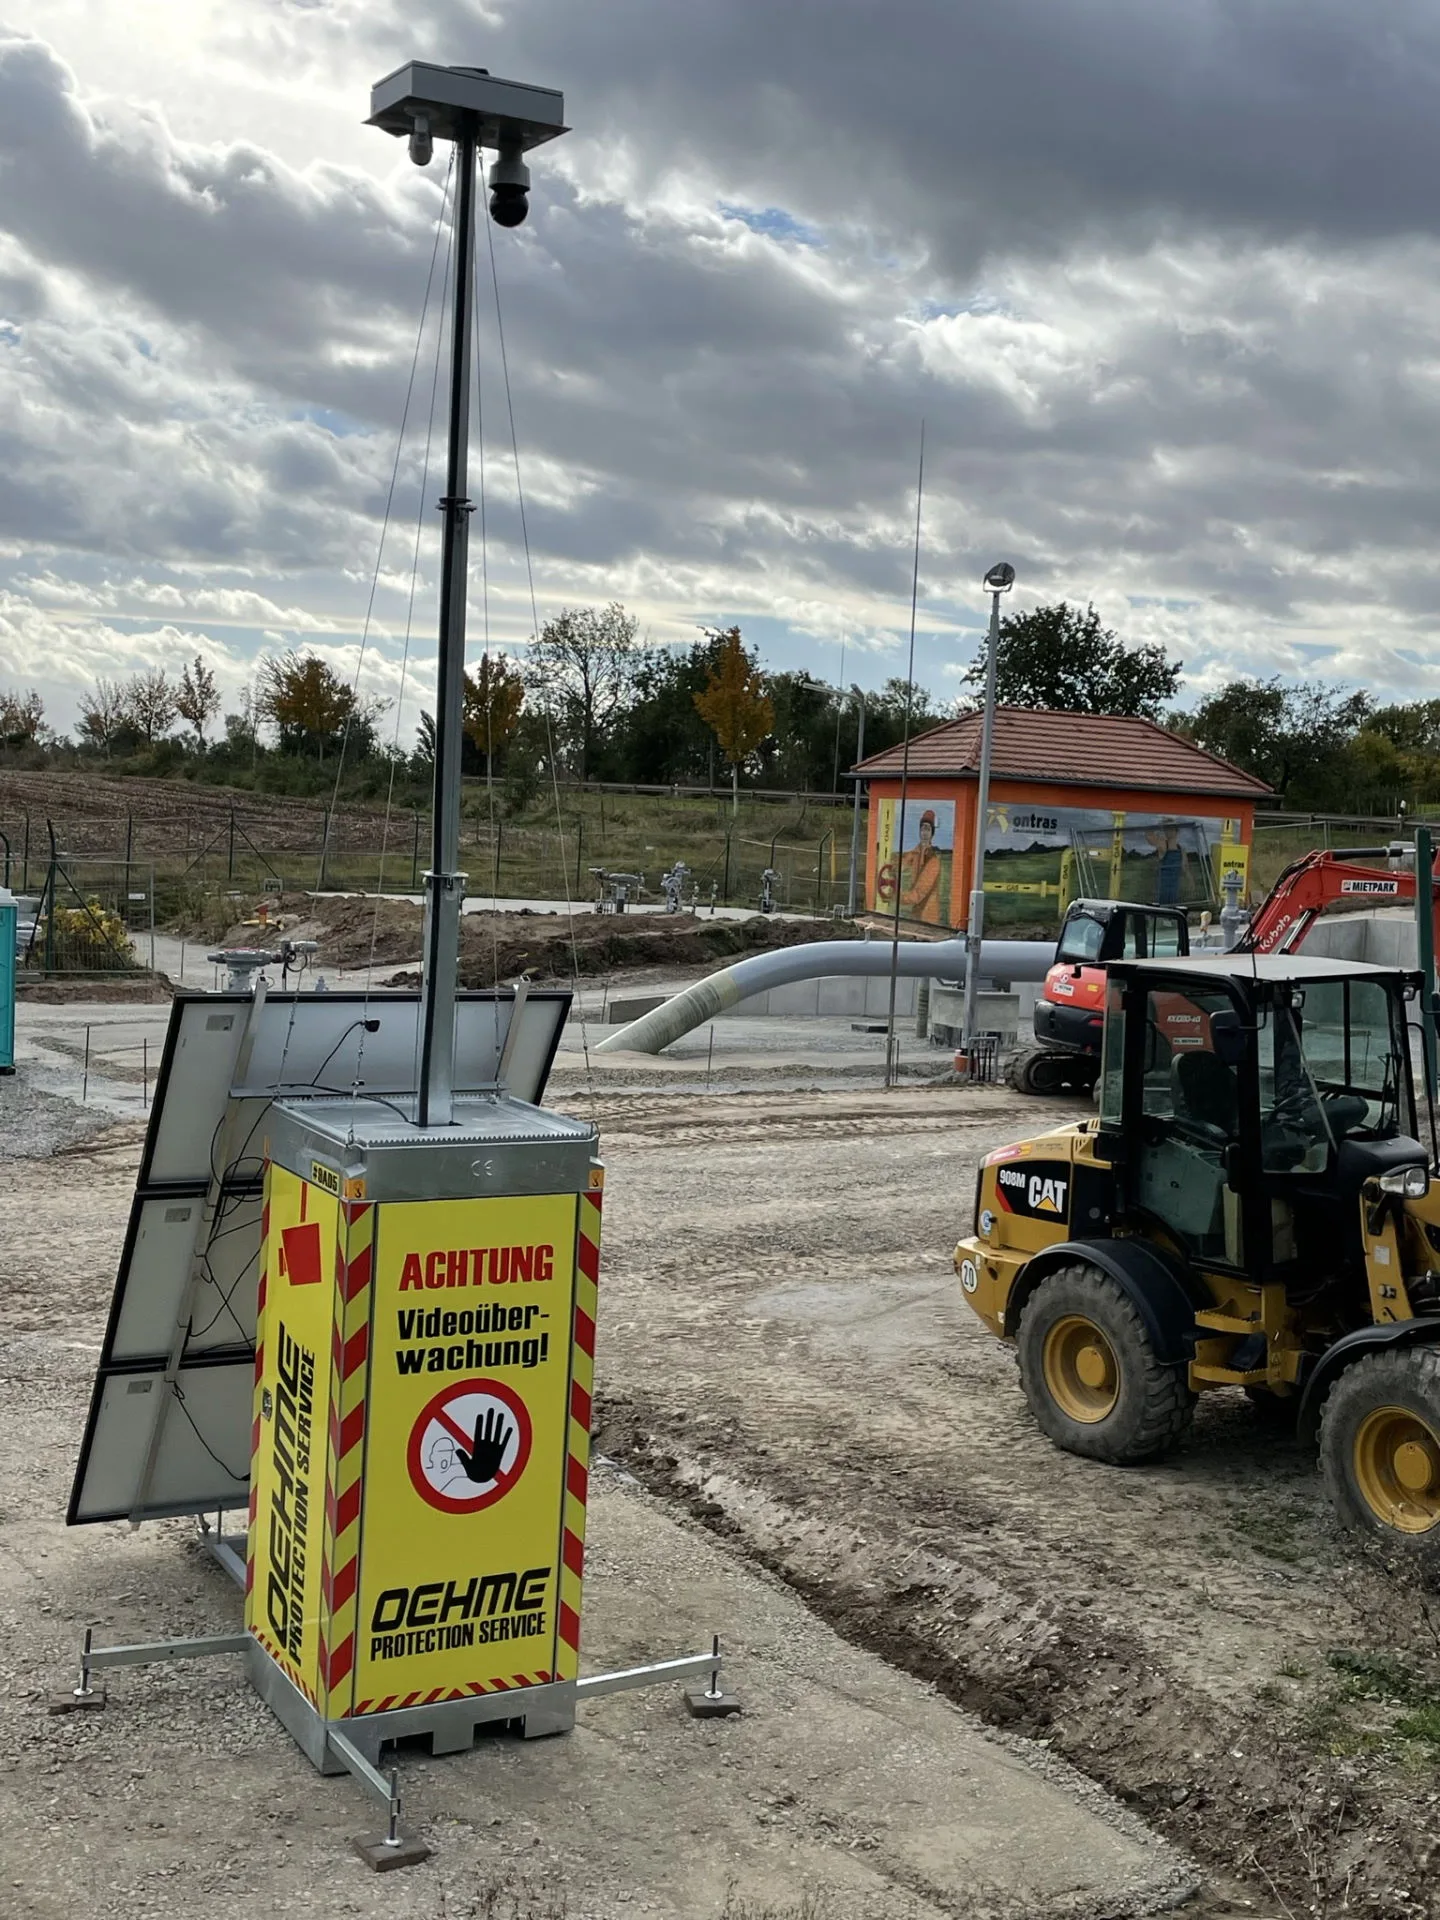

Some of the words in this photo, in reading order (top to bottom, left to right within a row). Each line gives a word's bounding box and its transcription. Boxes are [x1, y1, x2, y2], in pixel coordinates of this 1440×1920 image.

[1013, 813, 1057, 829] ontras
[1352, 882, 1395, 892] MIETPARK
[1260, 914, 1291, 950] Kubota
[999, 1169, 1026, 1188] 908M
[1028, 1176, 1067, 1213] CAT
[398, 1244, 554, 1291] ACHTUNG
[963, 1264, 974, 1287] 20
[397, 1303, 550, 1340] Videoüber-
[395, 1333, 548, 1375] wachung!
[296, 1343, 315, 1474] SERVICE
[267, 1320, 302, 1649] OEHME
[289, 1481, 310, 1667] PROTECTION
[370, 1567, 552, 1633] OEHME
[370, 1624, 474, 1662] PROTECTION
[478, 1612, 547, 1648] SERVICE
